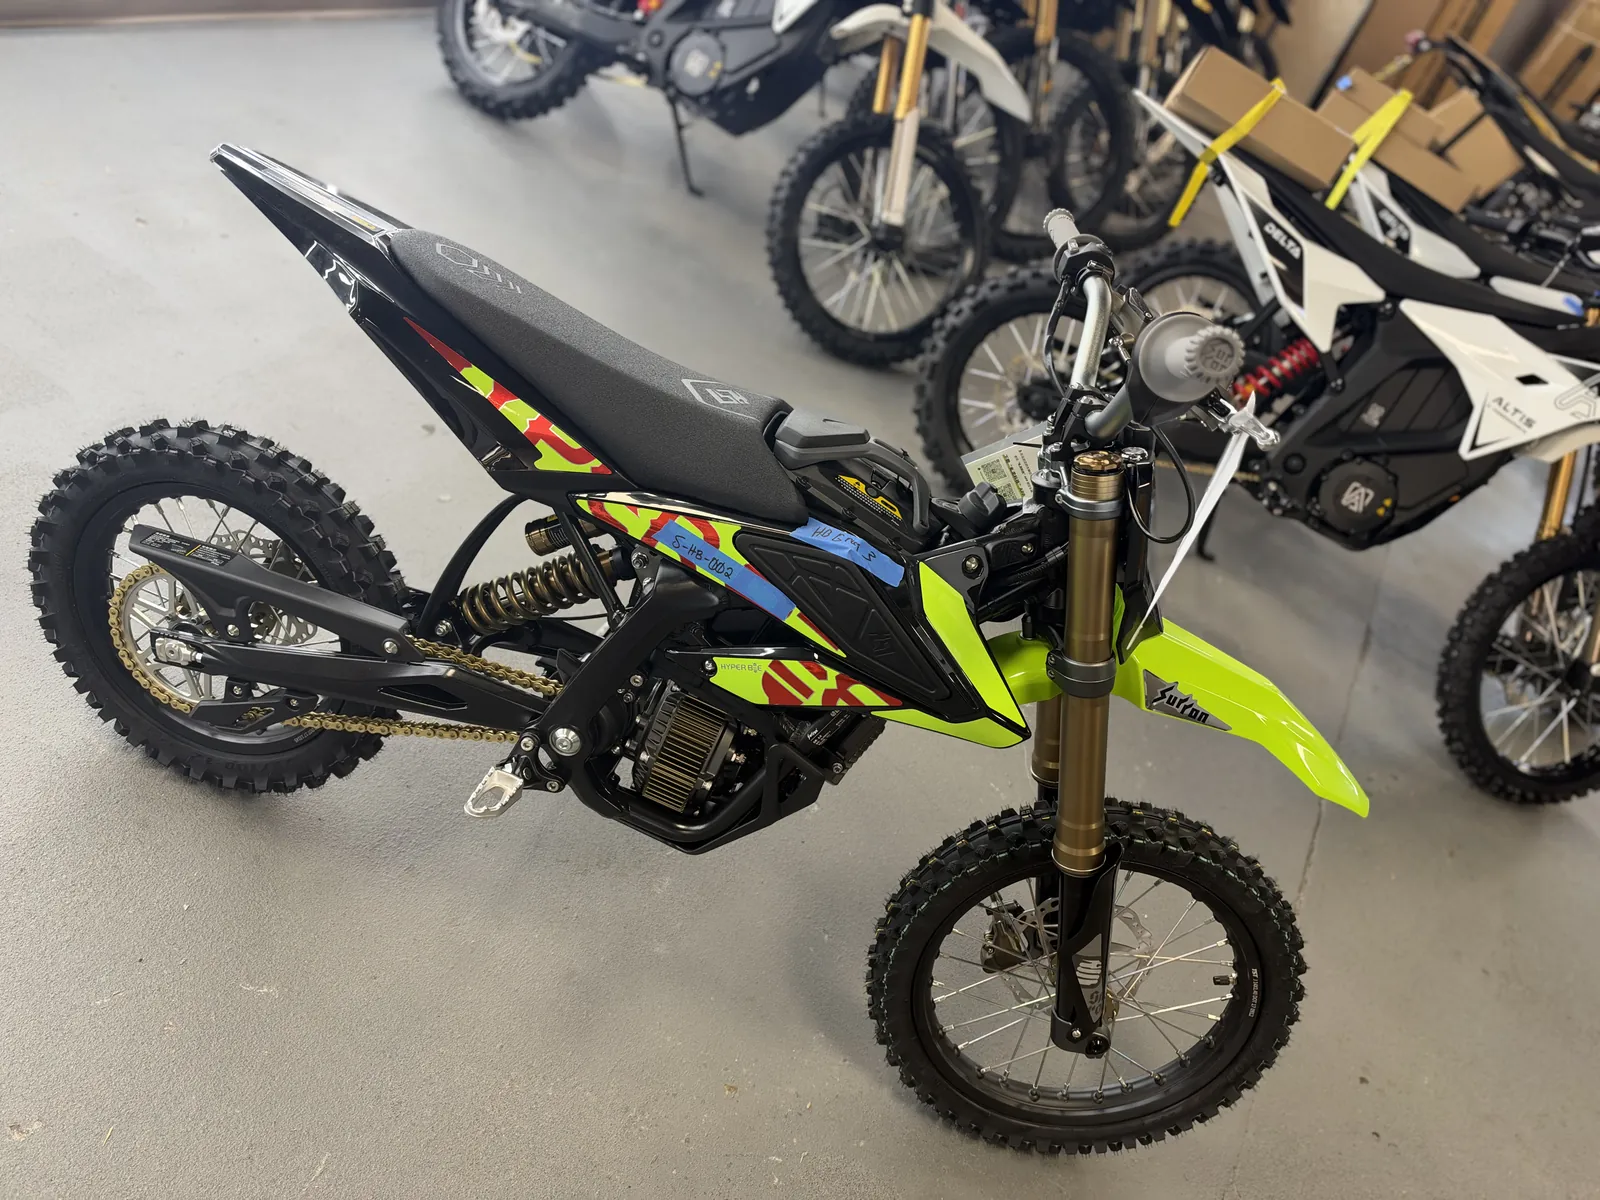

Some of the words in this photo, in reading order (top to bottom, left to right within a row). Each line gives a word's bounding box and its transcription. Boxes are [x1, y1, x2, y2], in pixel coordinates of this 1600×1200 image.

[1263, 221, 1301, 260] DELTA
[1491, 396, 1536, 429] ALTIS
[861, 550, 877, 562] 3
[720, 662, 747, 671] HYPER
